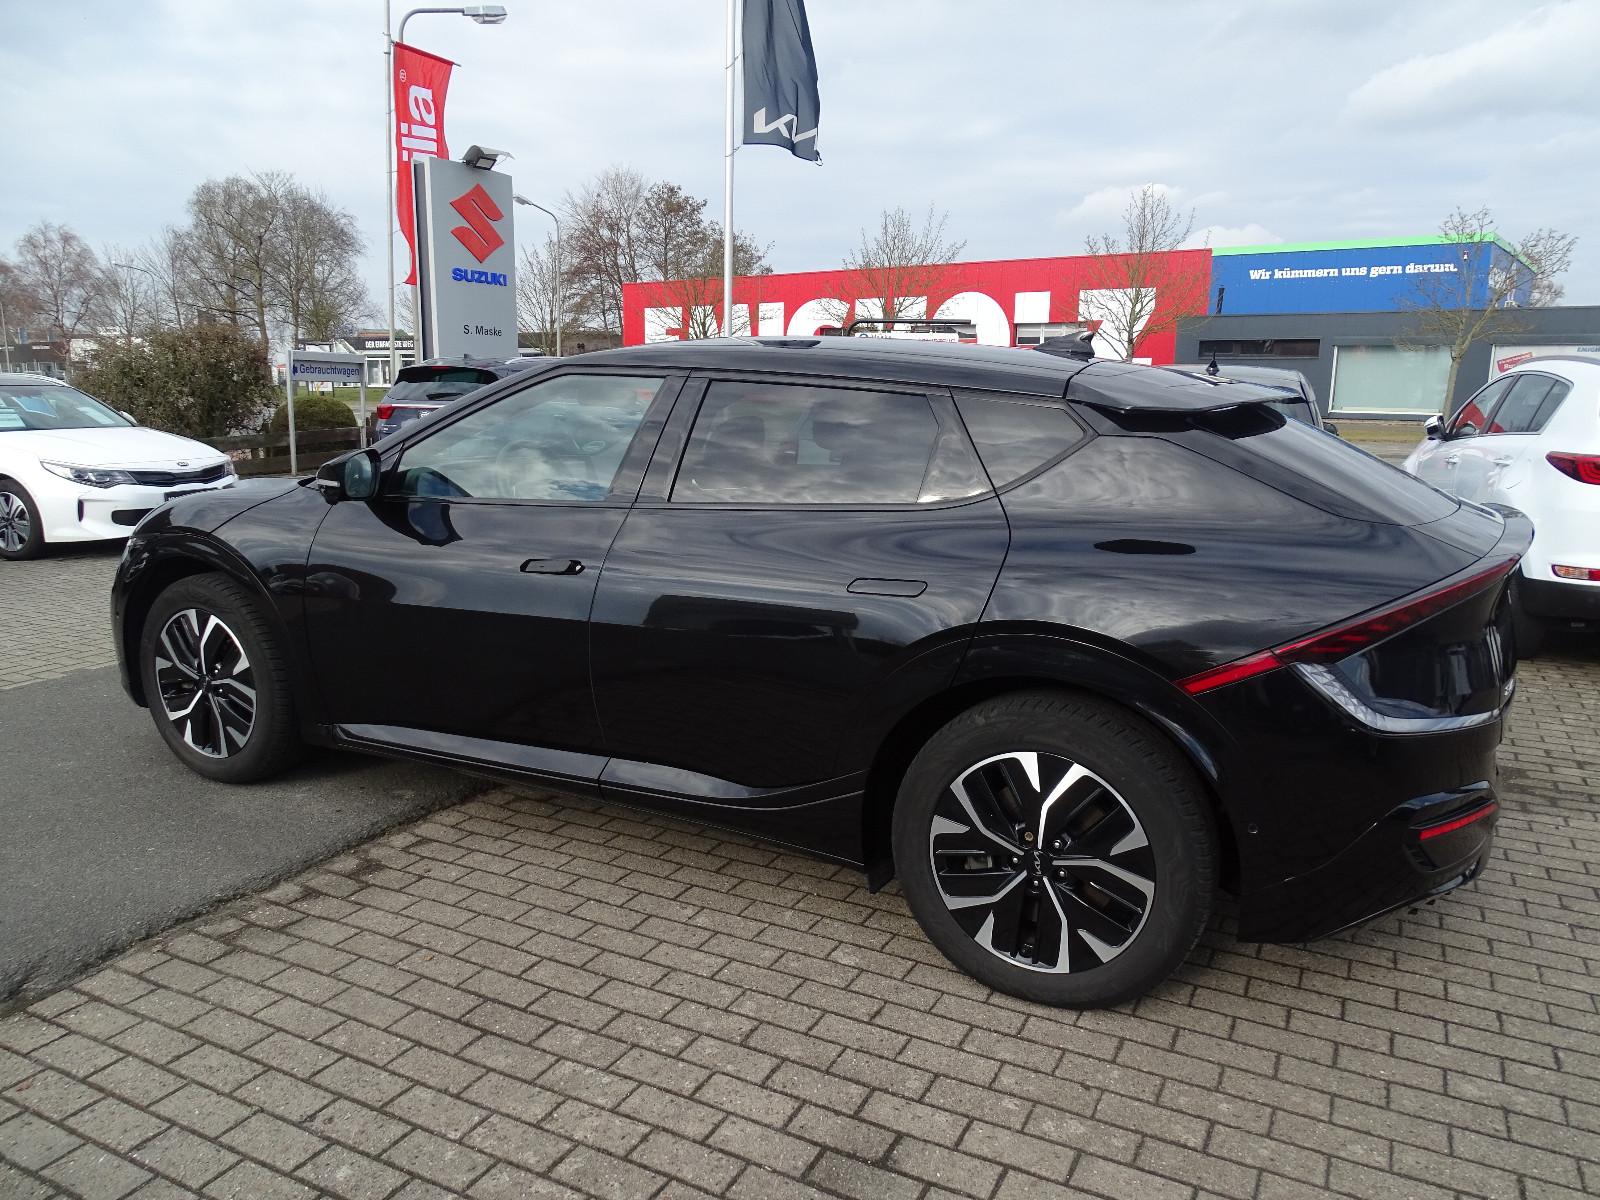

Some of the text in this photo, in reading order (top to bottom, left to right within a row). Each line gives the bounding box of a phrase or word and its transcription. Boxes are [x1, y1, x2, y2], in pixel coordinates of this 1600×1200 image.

[452, 267, 508, 287] SUZUKI
[1249, 262, 1458, 280] Wir kümmern uns gern darum.
[463, 324, 503, 337] S. Maske
[299, 363, 360, 378] Gebrauchtwagen
